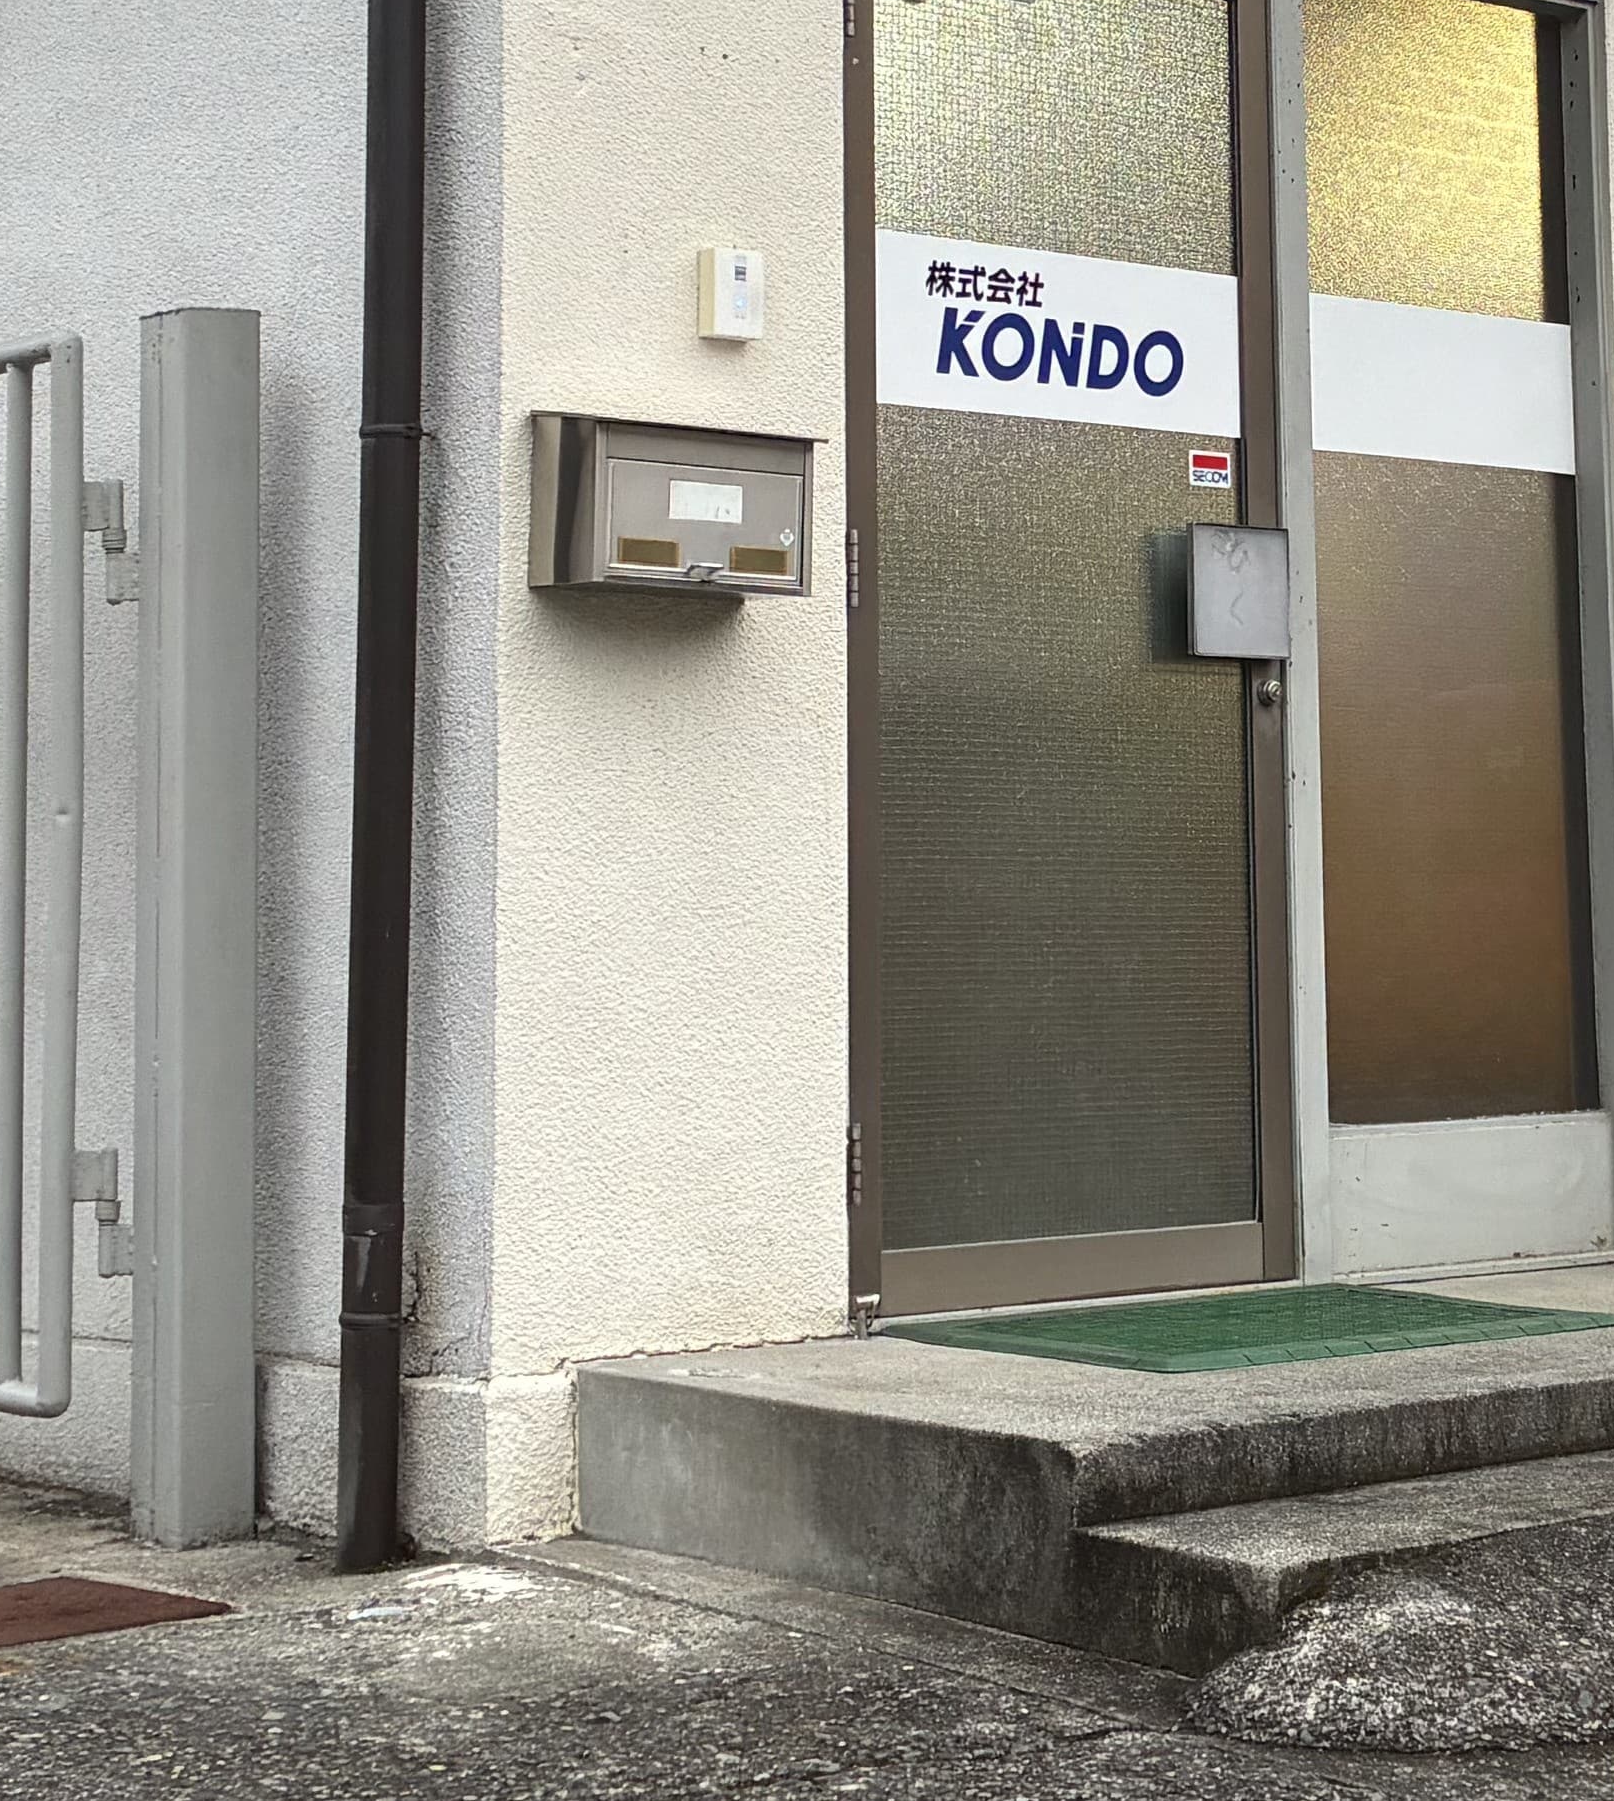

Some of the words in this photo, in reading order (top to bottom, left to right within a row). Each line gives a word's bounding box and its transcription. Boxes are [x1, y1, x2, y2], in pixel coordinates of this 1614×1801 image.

[926, 261, 1044, 307] 株式会社
[936, 307, 1183, 396] KONDO
[1192, 470, 1229, 485] SECOM
